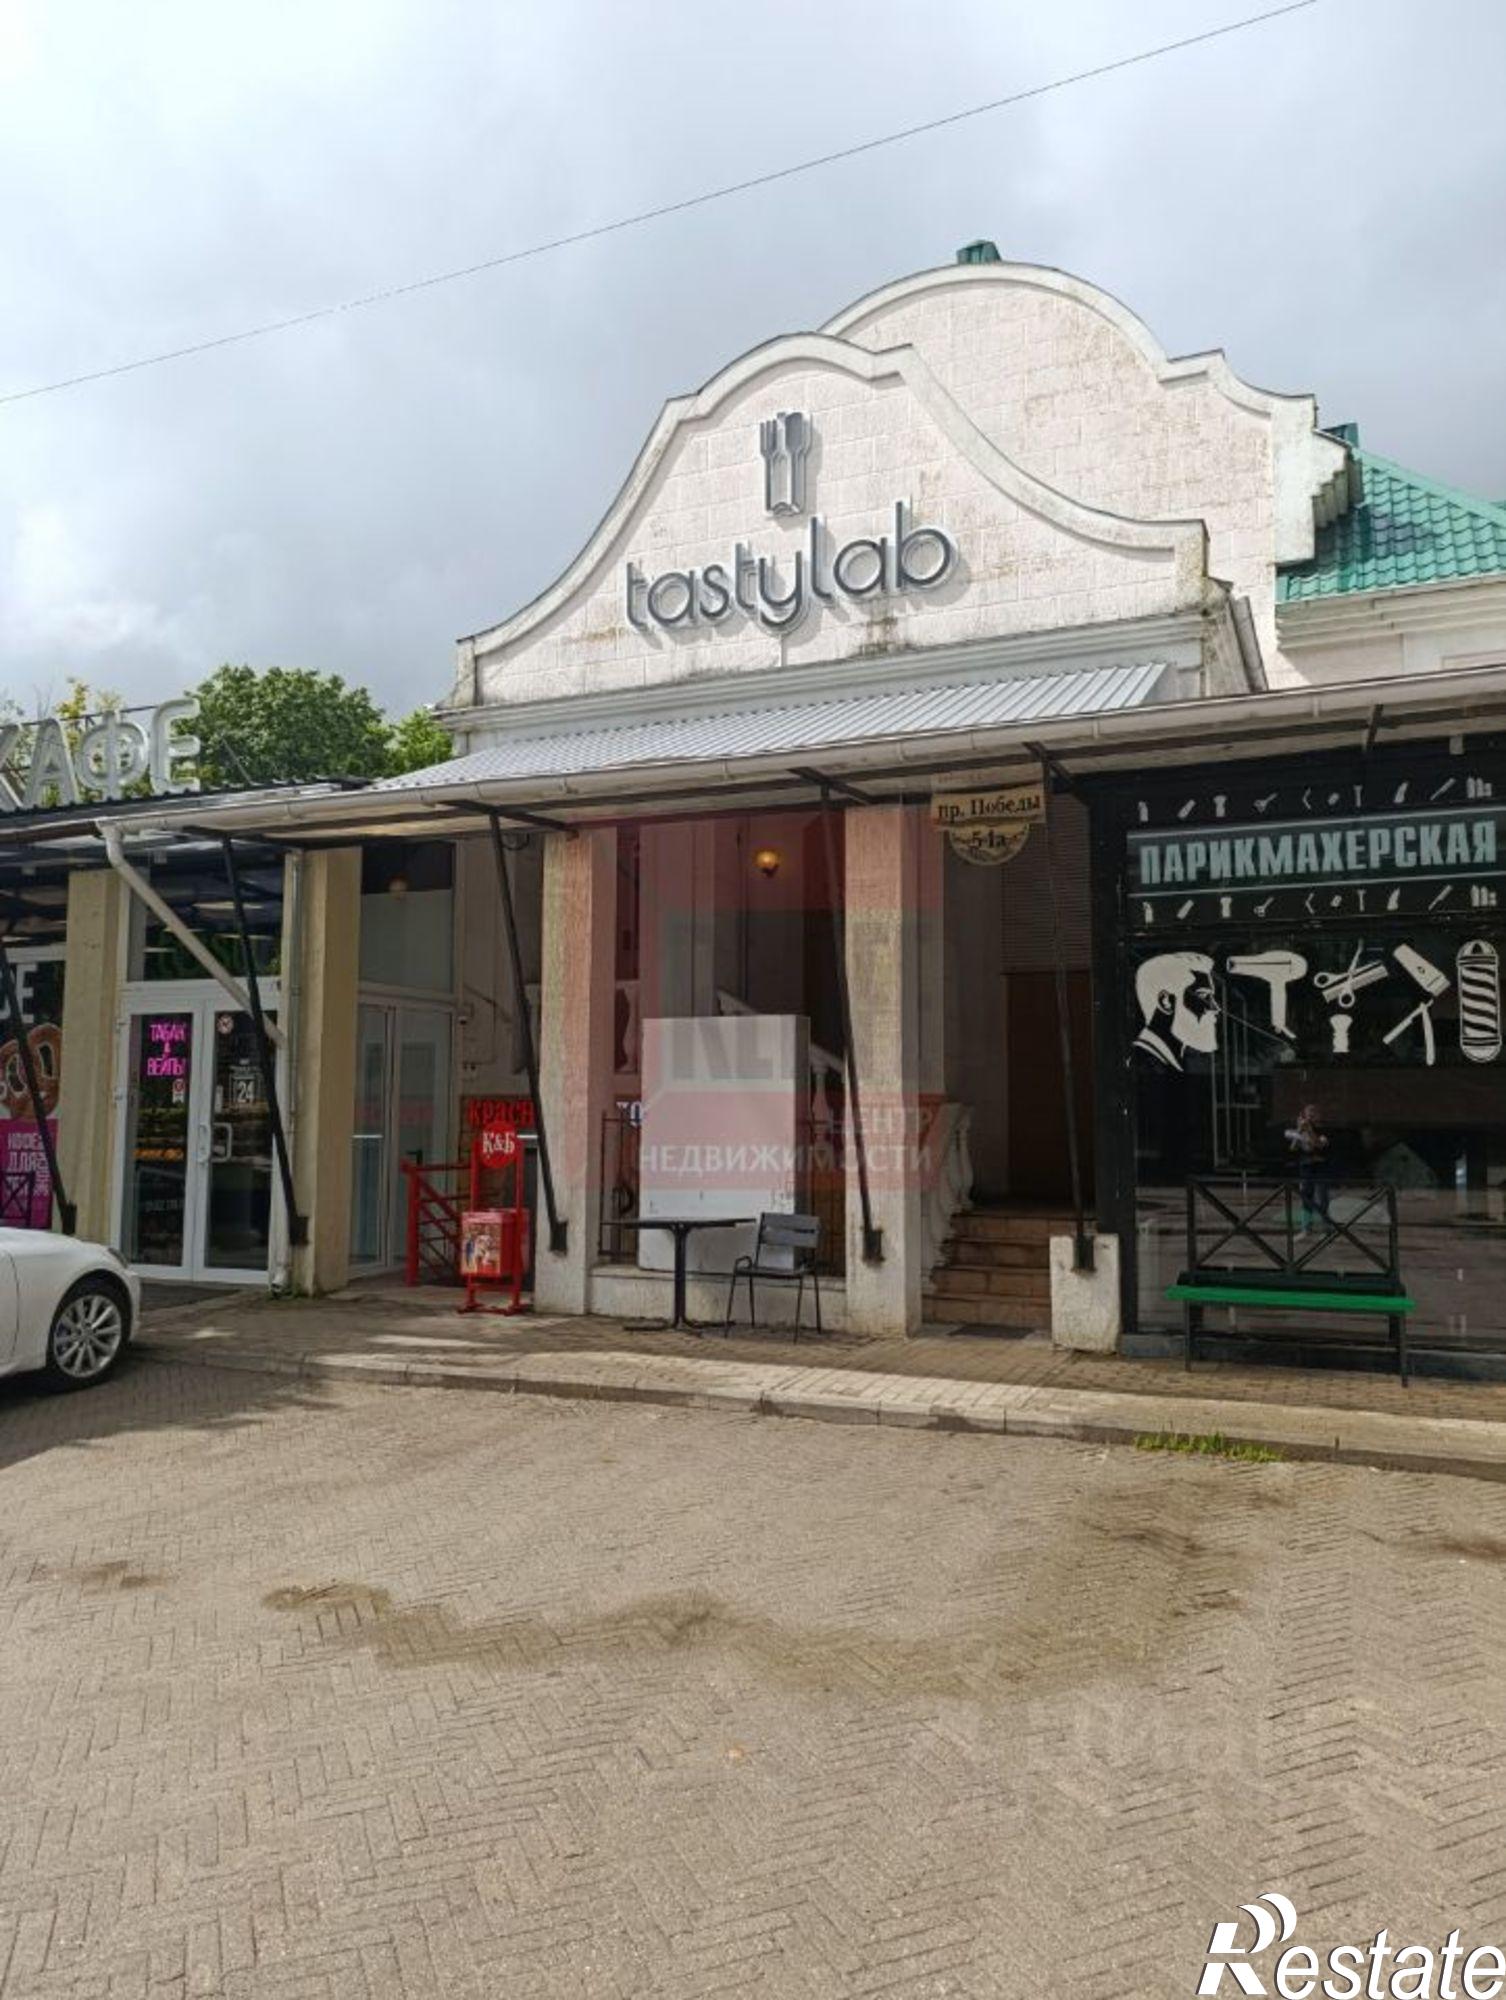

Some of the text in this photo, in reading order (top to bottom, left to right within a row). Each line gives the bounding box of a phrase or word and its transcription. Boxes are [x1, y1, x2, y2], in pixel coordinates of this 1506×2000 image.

[627, 500, 952, 627] tastylab
[938, 795, 1041, 824] пр. Победы
[1139, 820, 1497, 884] ПАРИКМАХЕРСКАЯ
